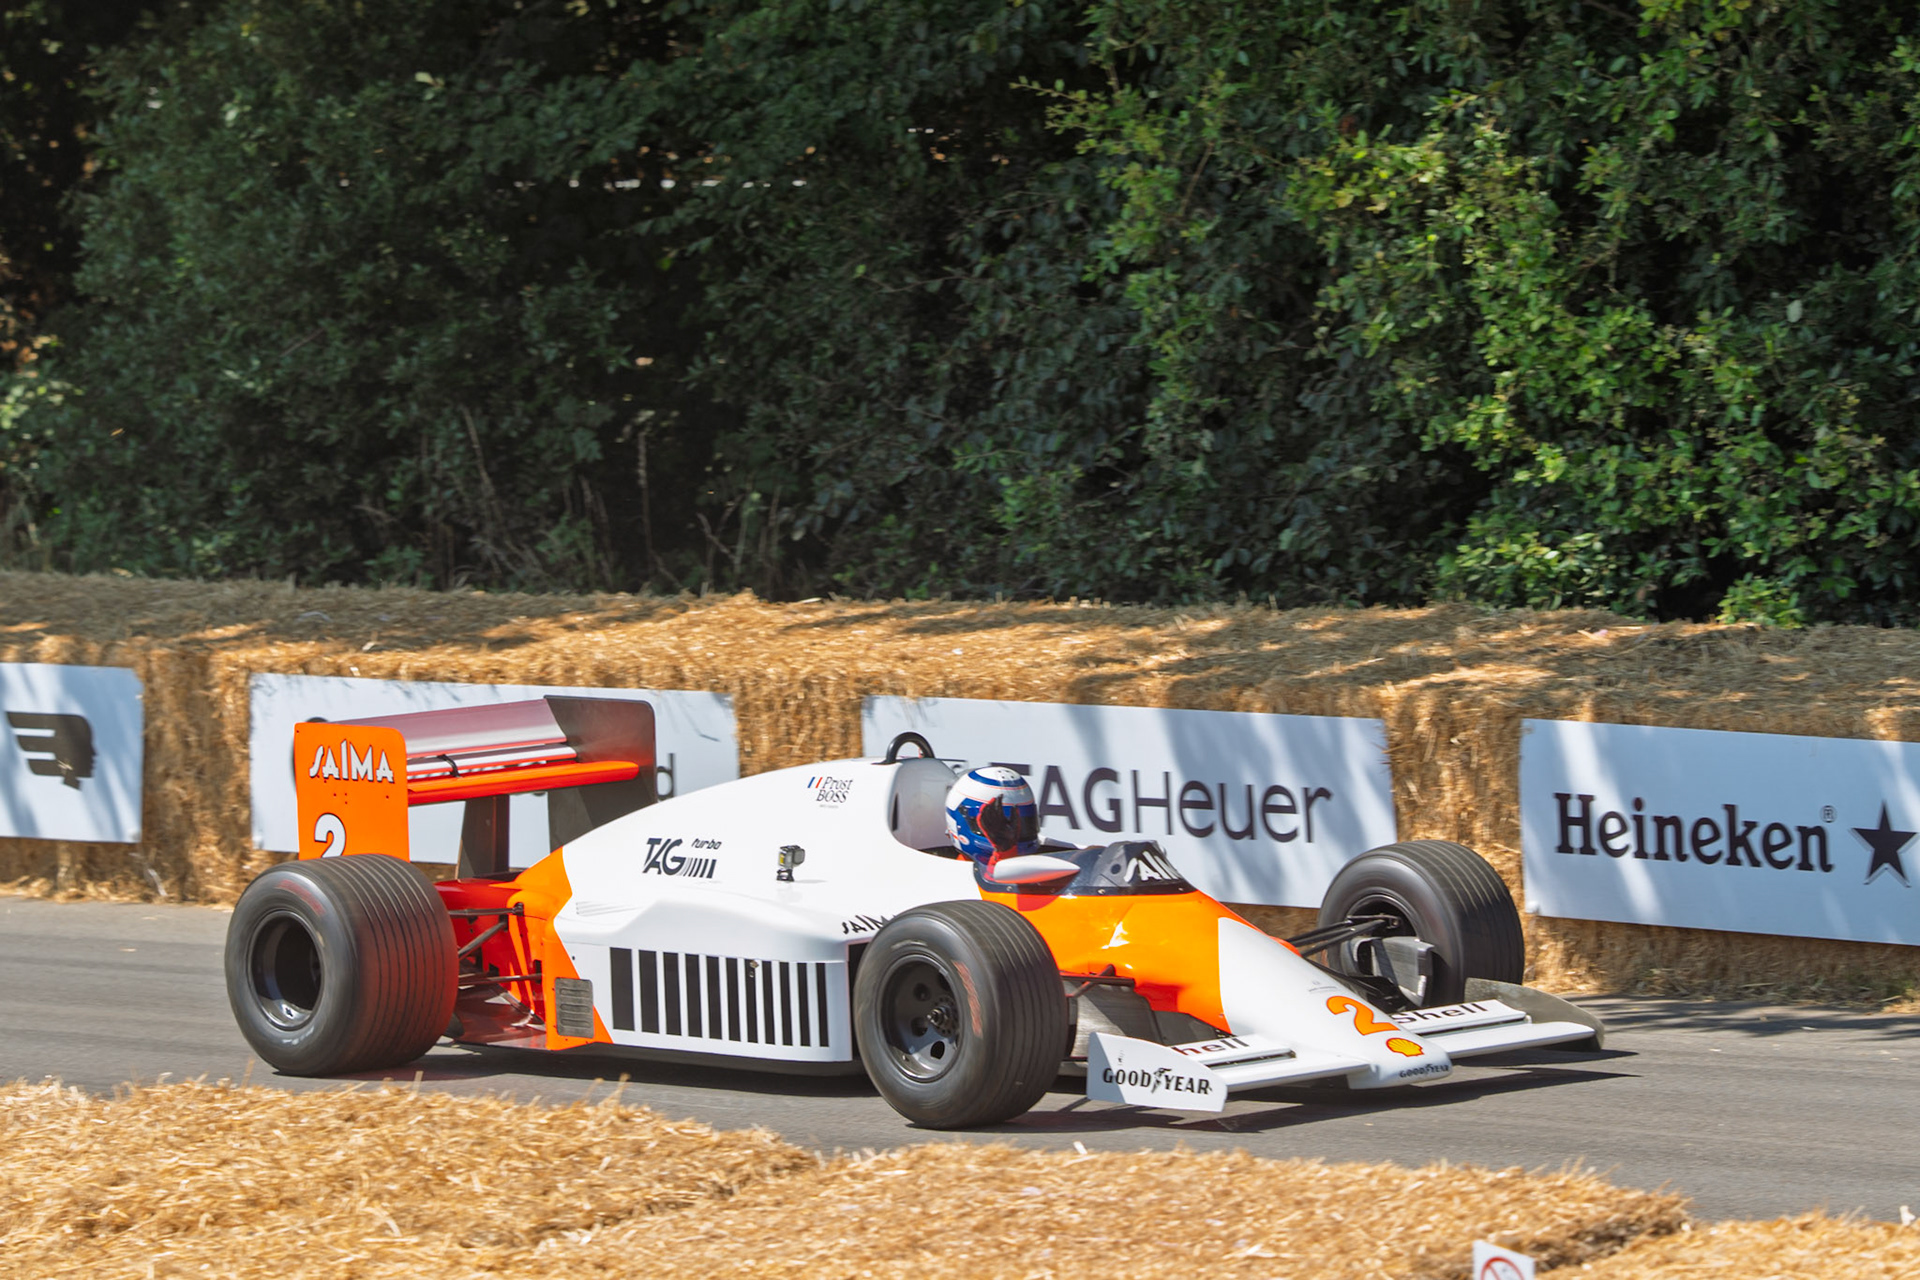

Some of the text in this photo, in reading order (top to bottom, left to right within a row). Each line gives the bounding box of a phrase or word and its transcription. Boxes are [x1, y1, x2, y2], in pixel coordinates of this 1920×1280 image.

[308, 738, 396, 784] SAIMA
[822, 776, 853, 790] Prost
[816, 789, 849, 803] BOSS
[314, 812, 347, 858] 2
[642, 837, 722, 876] TAG turbo
[841, 914, 897, 934] SAIM
[1326, 995, 1401, 1036] 2
[1392, 1003, 1488, 1024] Shell
[1171, 1037, 1250, 1056] hell
